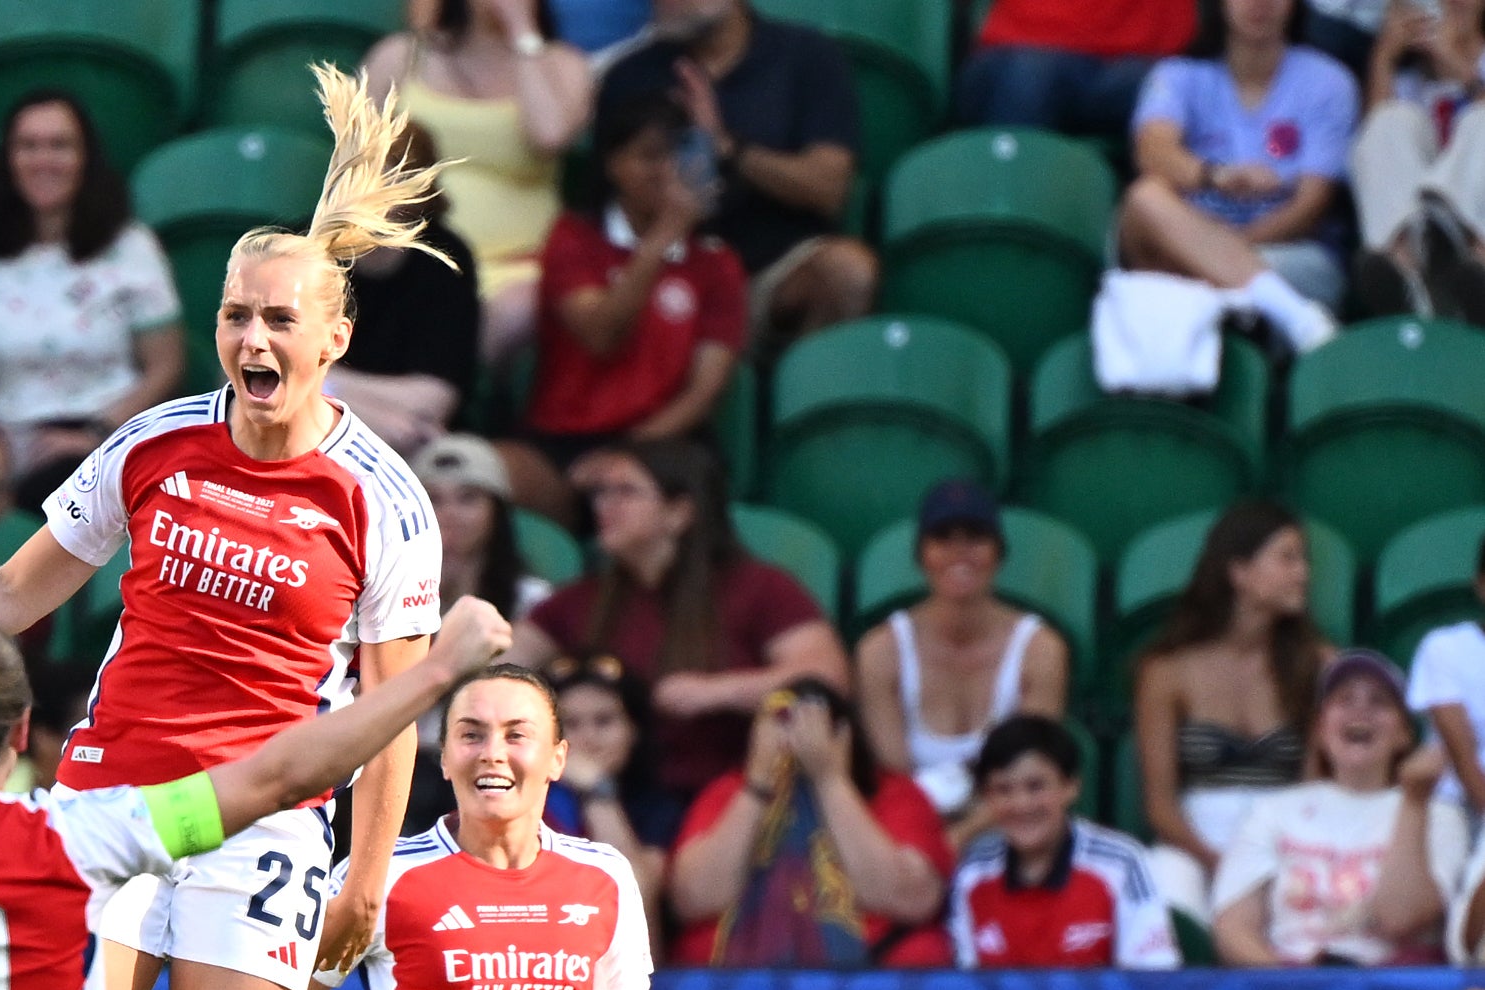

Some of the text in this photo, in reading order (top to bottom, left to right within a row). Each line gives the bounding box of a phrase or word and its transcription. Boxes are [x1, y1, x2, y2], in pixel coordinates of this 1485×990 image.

[149, 509, 310, 588] Emirates
[159, 554, 276, 612] FLY BETTER
[246, 850, 327, 941] 25
[442, 943, 591, 983] Emirates
